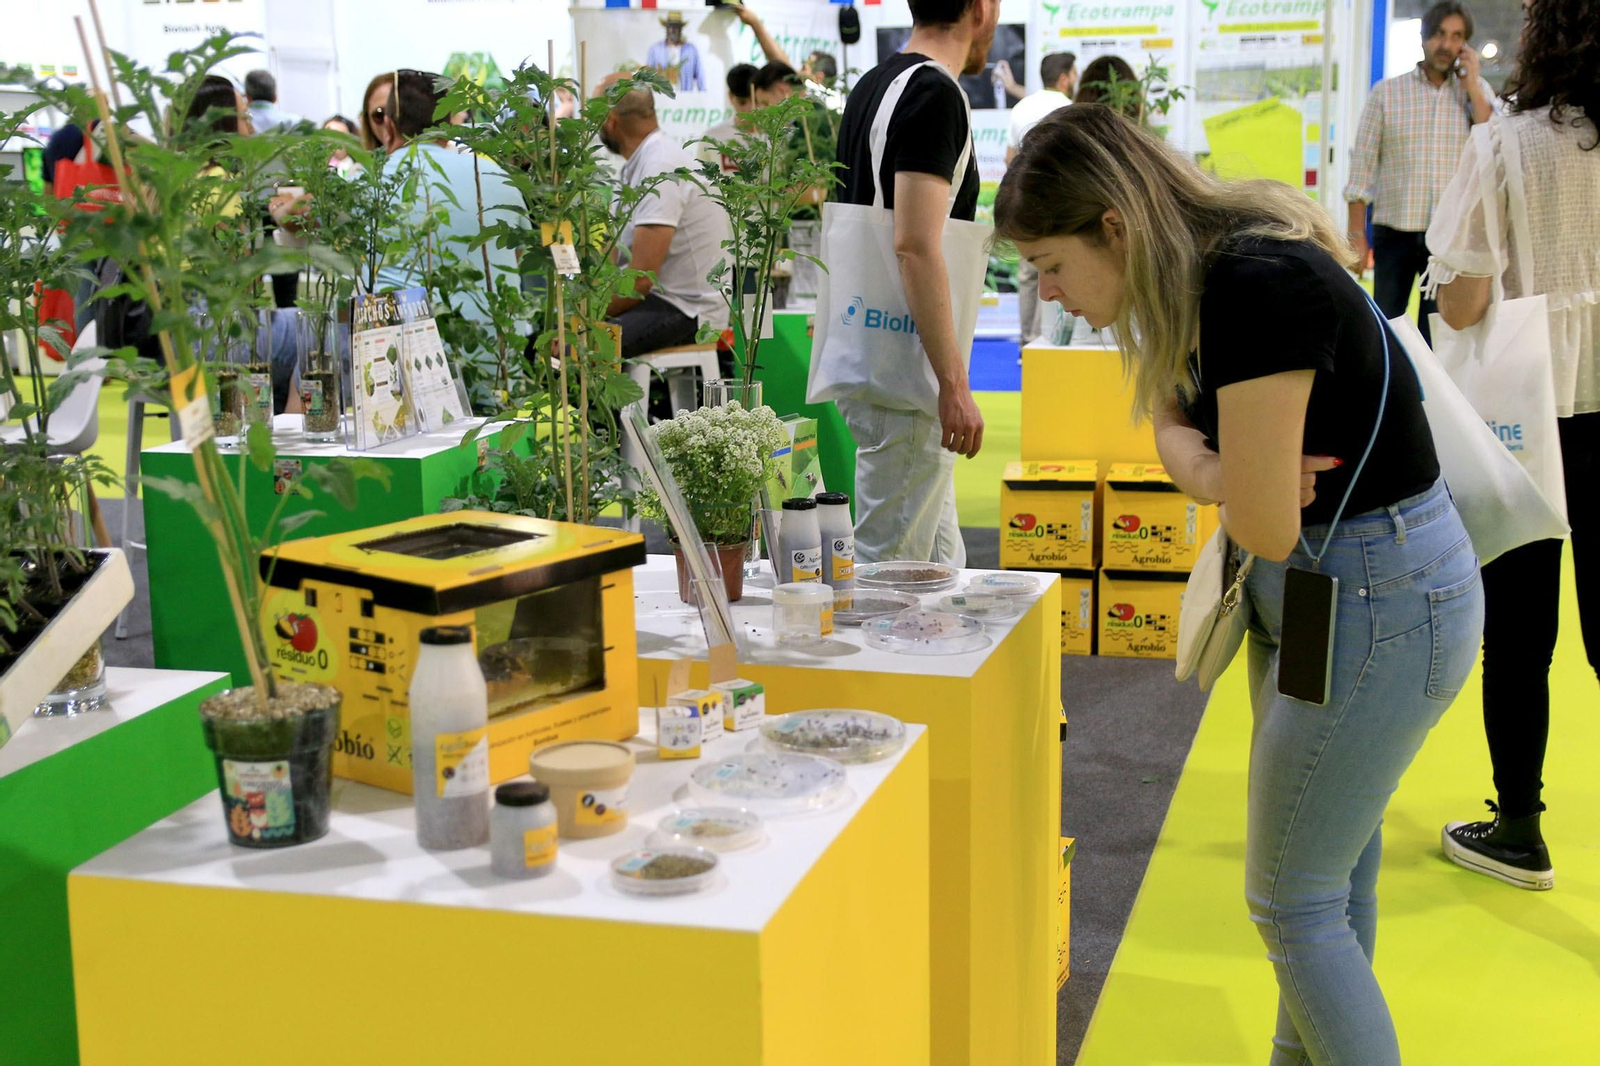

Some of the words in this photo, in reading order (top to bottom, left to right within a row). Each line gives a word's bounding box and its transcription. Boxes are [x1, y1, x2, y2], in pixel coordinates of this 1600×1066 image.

[1067, 4, 1175, 20] Ecotrampa
[1225, 0, 1324, 17] Ecotramp
[1485, 421, 1523, 442] ine
[276, 648, 316, 667] residuo
[317, 649, 328, 670] 0
